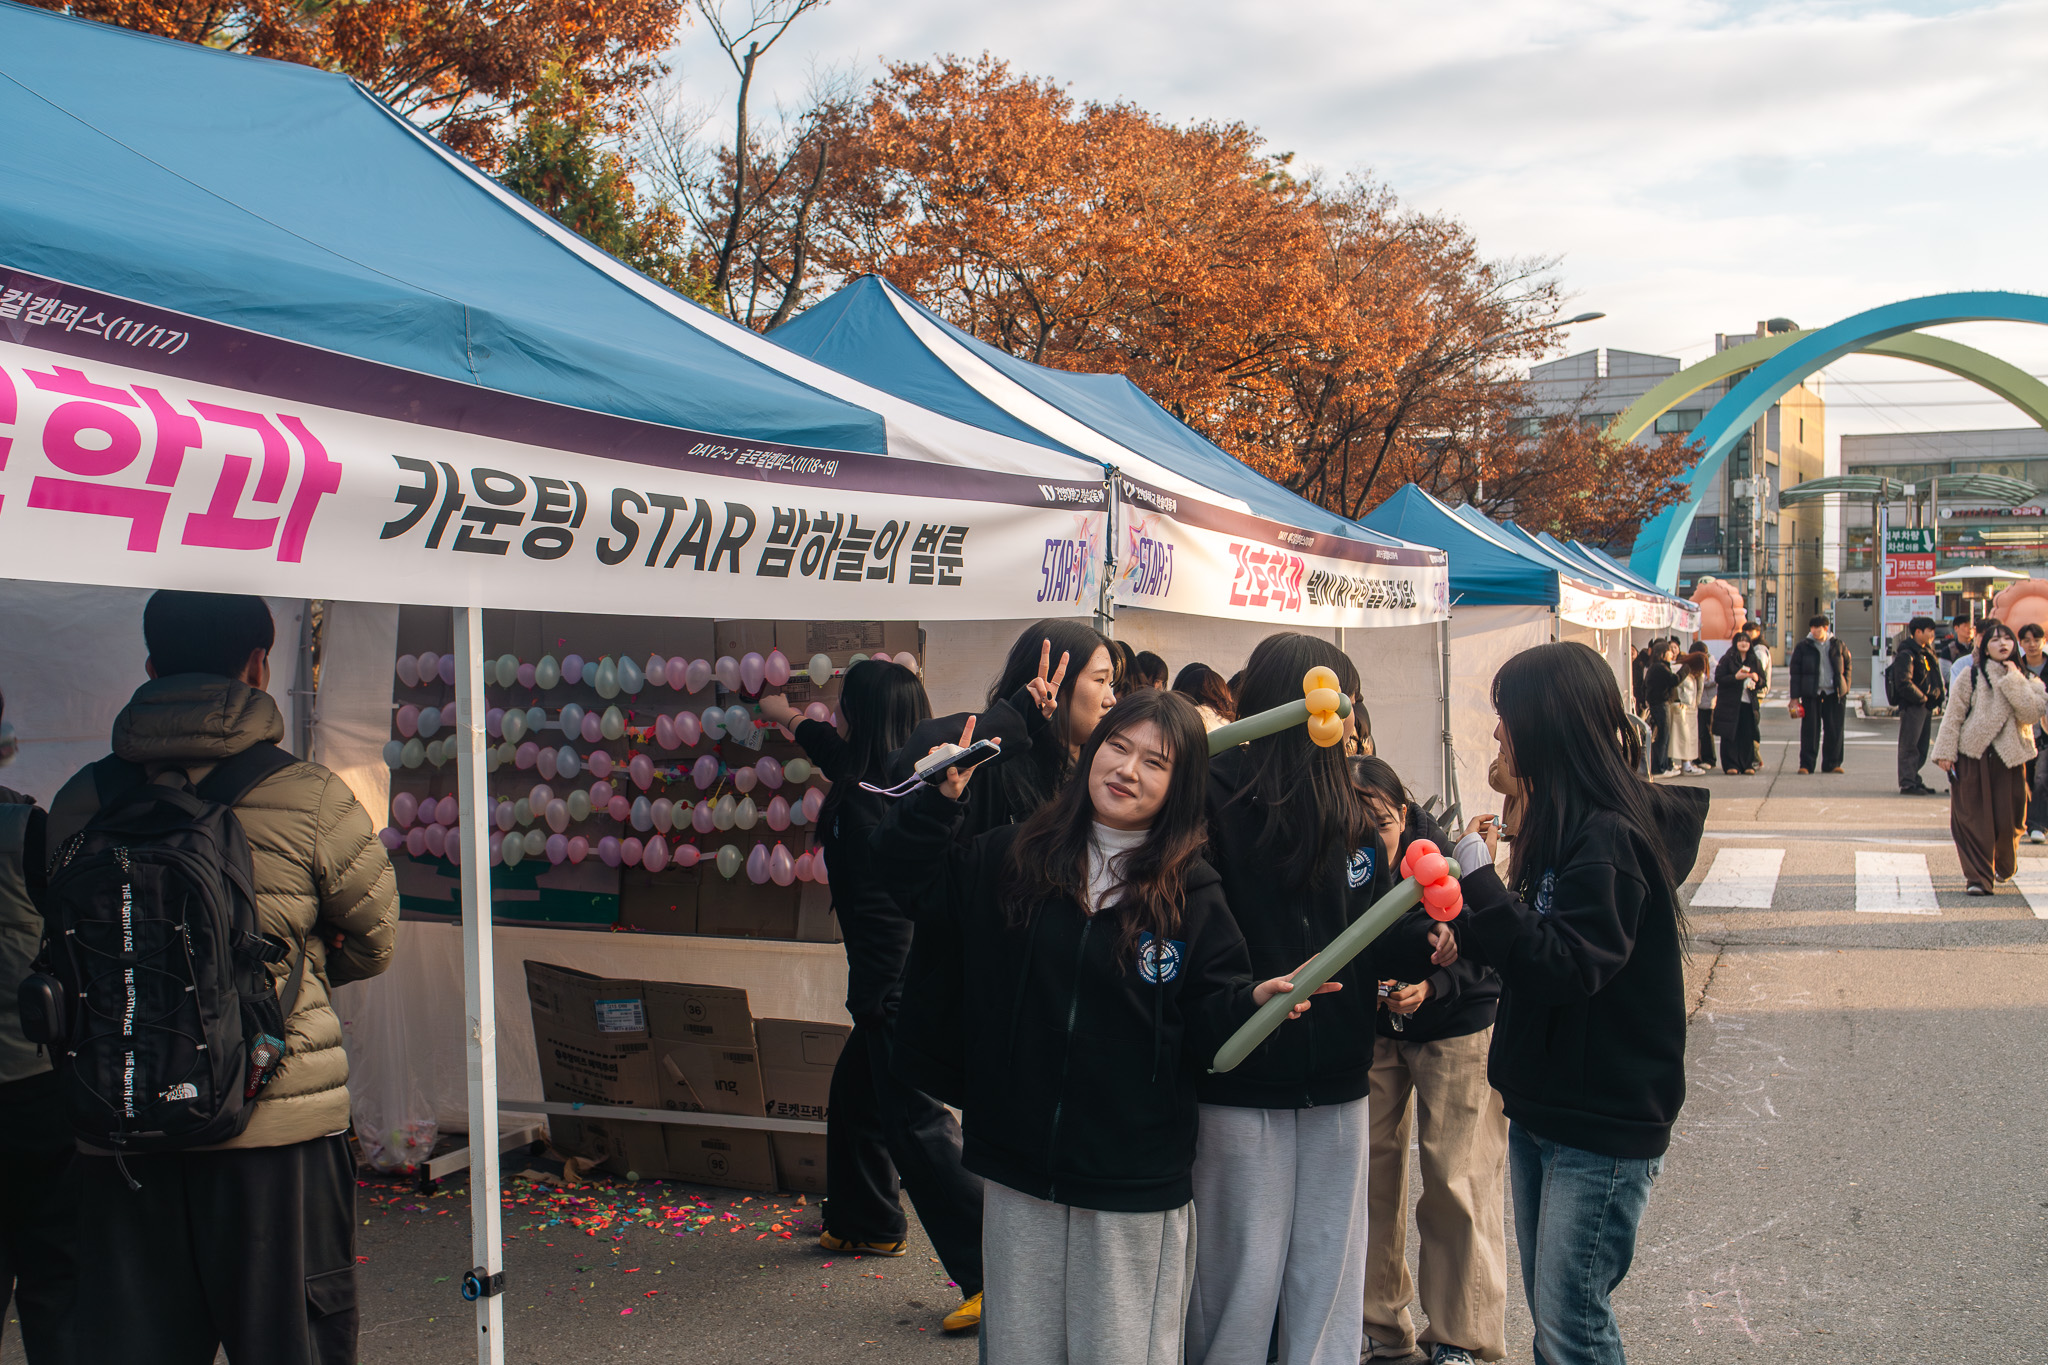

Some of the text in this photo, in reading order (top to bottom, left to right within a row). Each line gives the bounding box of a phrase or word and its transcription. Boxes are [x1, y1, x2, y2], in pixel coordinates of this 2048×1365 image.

[0, 283, 190, 355] 컬캠퍼스(11/17)
[687, 442, 739, 462] DAY2~3
[379, 453, 589, 561] 카운팅
[595, 487, 757, 574] STAR
[756, 505, 911, 584] 밤하늘의
[908, 523, 970, 587] 벌룬
[1228, 542, 1305, 613] 간호학과
[121, 883, 133, 952] THE NORTH FACE
[123, 967, 136, 1036] THE NORTH FACE
[688, 1004, 702, 1015] 36
[123, 1067, 135, 1096] NORTH
[124, 1050, 135, 1066] THE
